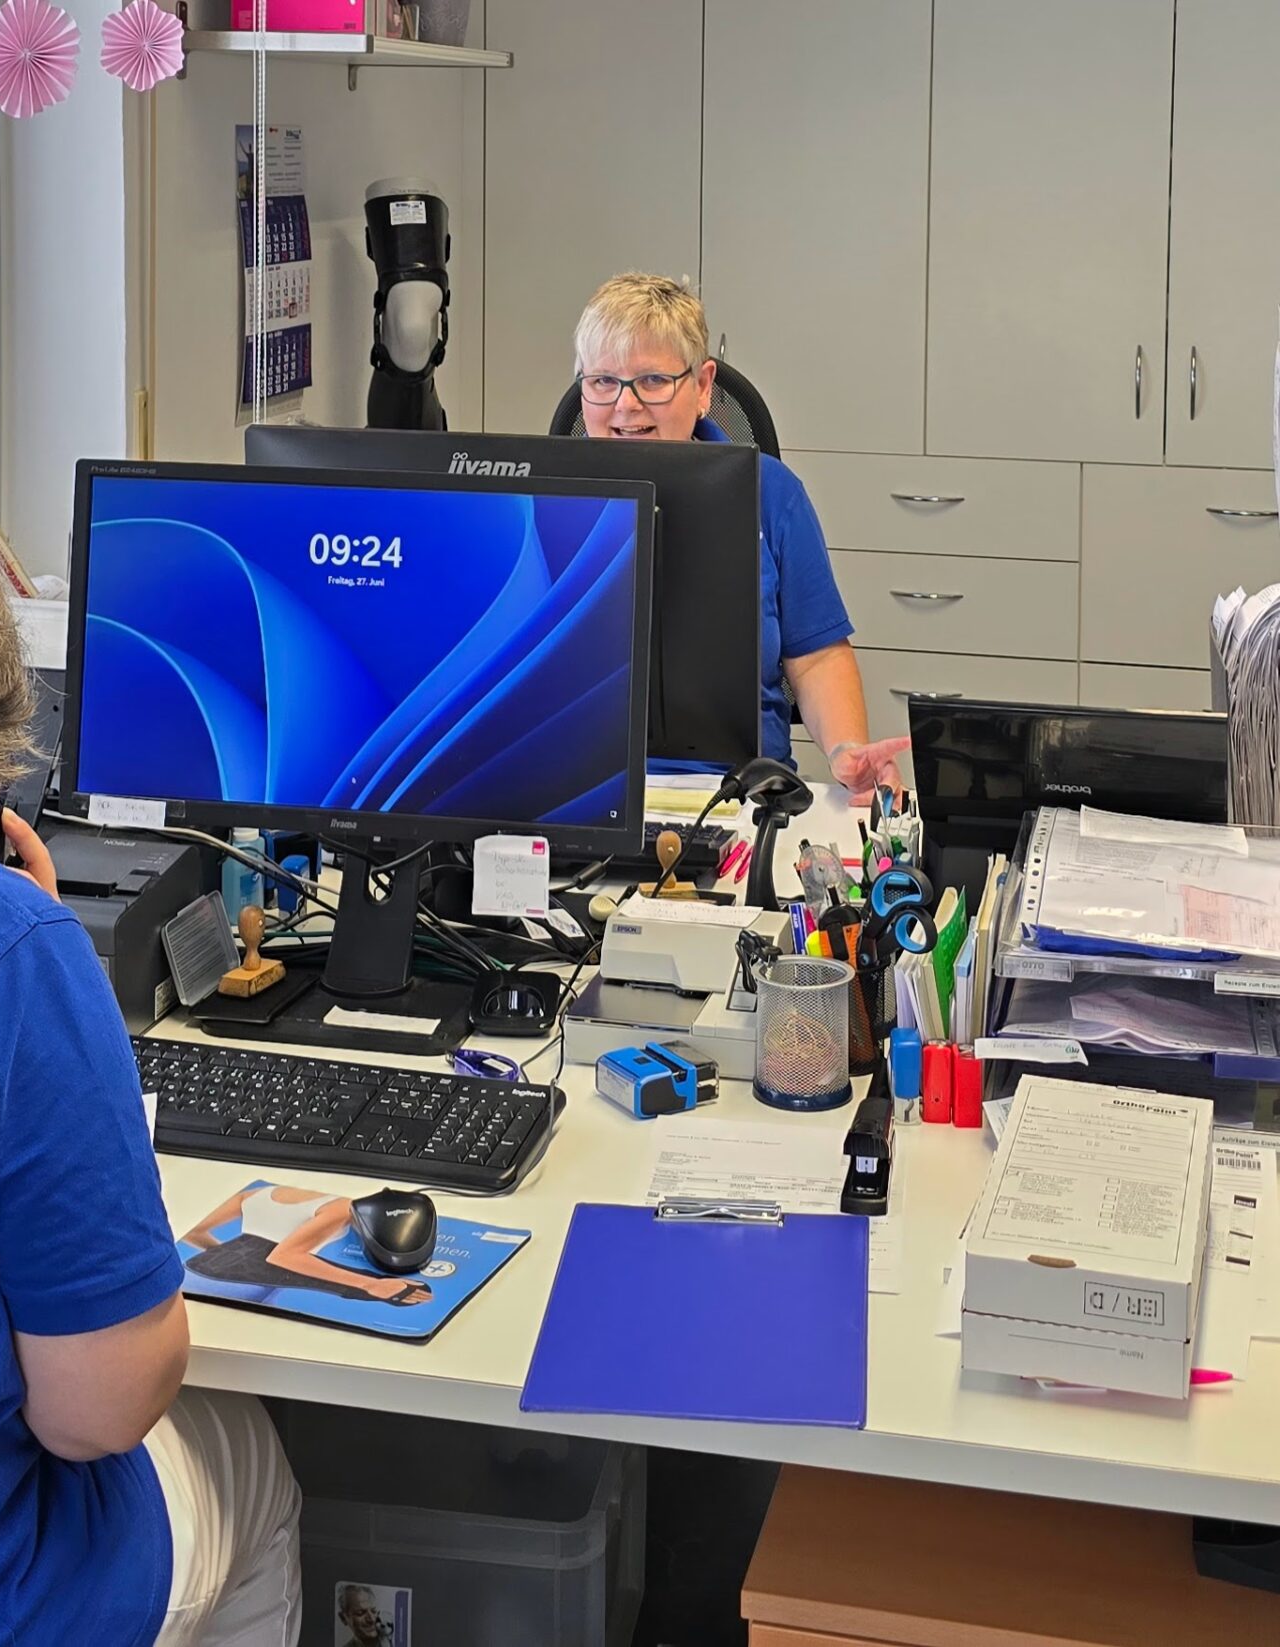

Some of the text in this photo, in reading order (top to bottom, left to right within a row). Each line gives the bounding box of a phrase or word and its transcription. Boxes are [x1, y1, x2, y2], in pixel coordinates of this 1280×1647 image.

[310, 533, 403, 568] 09:24
[328, 576, 385, 587] Freitag, 27. Juni
[1045, 784, 1091, 795] brother
[617, 925, 637, 933] EPSON
[512, 1088, 546, 1098] logitech
[385, 1207, 414, 1217] logitech
[1120, 1349, 1144, 1360] Name
